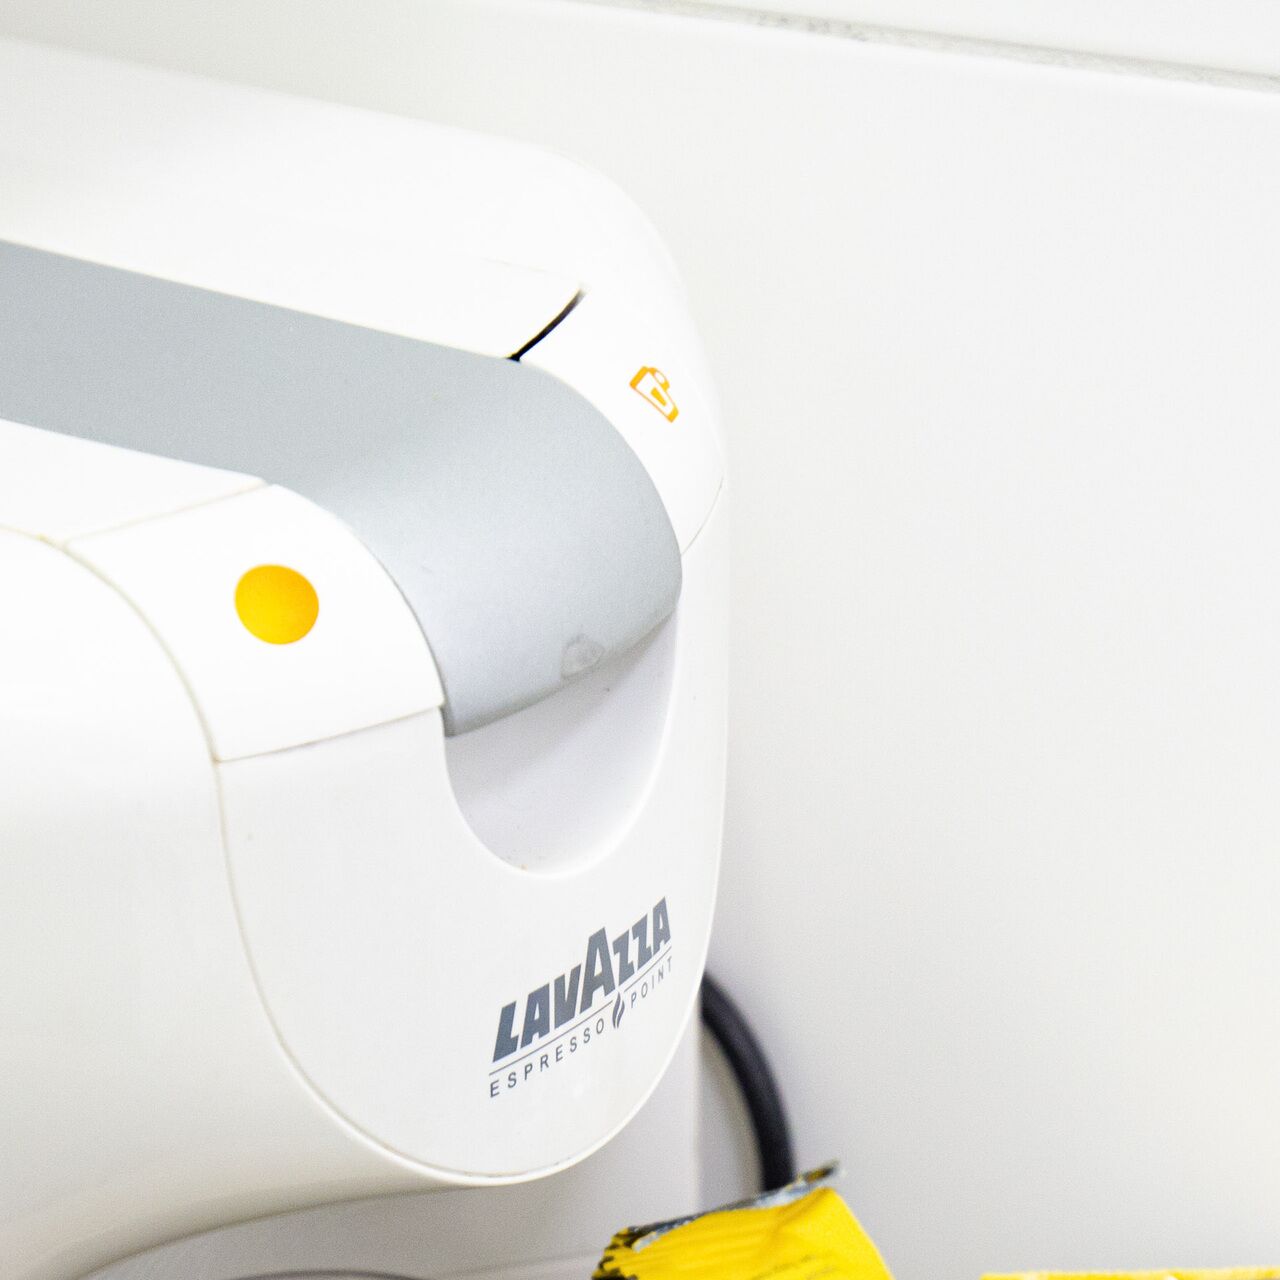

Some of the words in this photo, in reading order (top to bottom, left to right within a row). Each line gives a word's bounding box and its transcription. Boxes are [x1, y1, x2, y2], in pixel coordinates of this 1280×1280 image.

[489, 1017, 605, 1098] ESPRESSO
[629, 955, 672, 1009] POINT
[492, 896, 671, 1063] LAVAZZA
